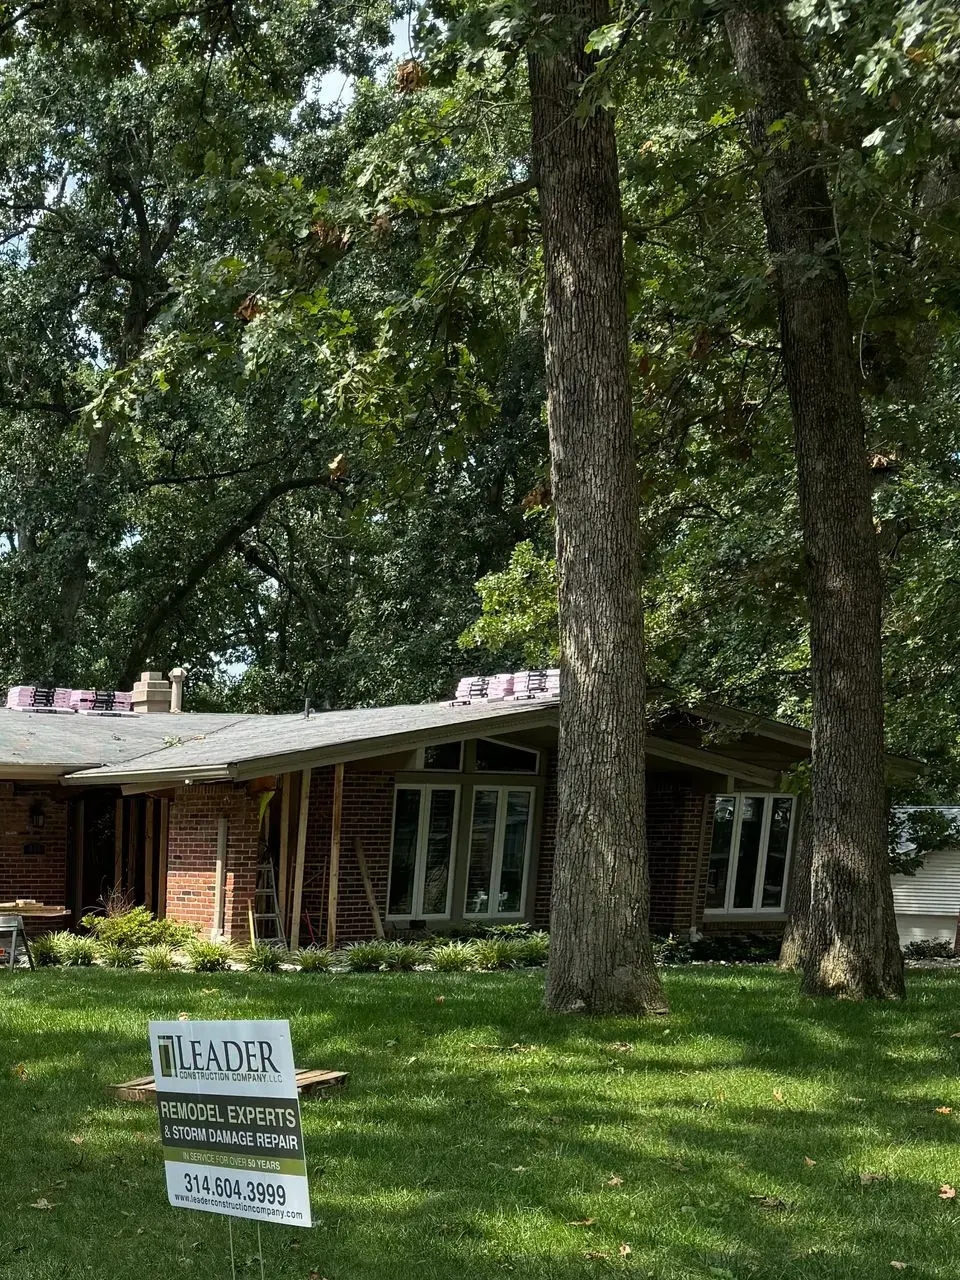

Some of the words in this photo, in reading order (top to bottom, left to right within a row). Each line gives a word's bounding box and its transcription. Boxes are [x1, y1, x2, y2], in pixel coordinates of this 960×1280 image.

[175, 1035, 281, 1073] LEADER
[180, 1071, 230, 1081] CONSTRUCTION
[161, 1101, 224, 1123] REMODEL
[227, 1105, 297, 1128] EXPERTS
[164, 1125, 171, 1138] &
[173, 1126, 207, 1142] STORM
[208, 1129, 254, 1146] DAMAGE
[257, 1134, 299, 1150] REPAIR
[182, 1151, 189, 1160] IN
[190, 1152, 215, 1163] SERVICE
[215, 1155, 229, 1165] FOR
[229, 1156, 247, 1167] OVER
[247, 1159, 256, 1168] 50
[256, 1160, 281, 1171] YEARS
[184, 1173, 286, 1206] 314.604.3999
[175, 1193, 303, 1219] www.leaderconstructioncompany.com
